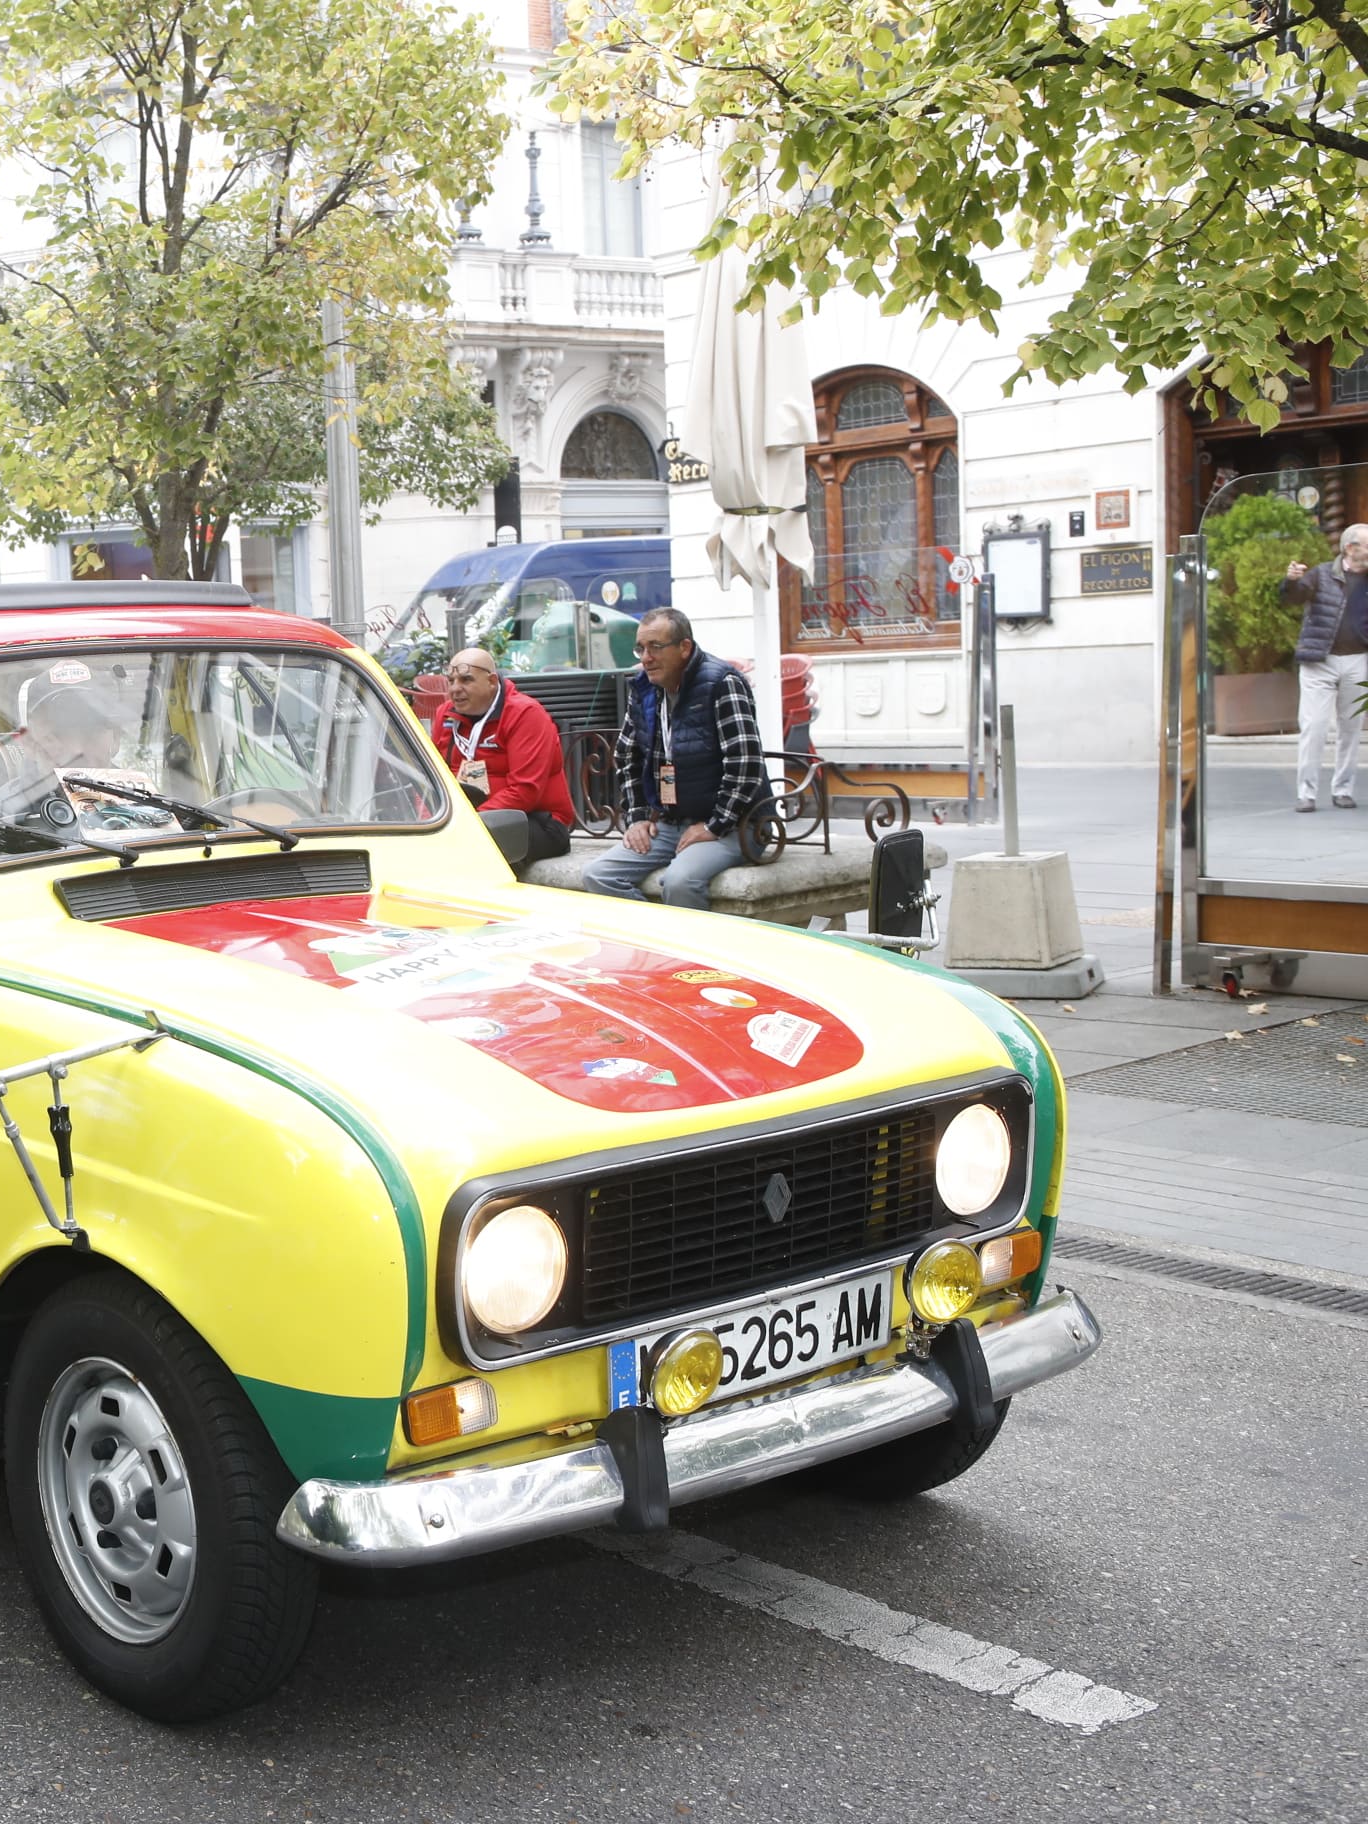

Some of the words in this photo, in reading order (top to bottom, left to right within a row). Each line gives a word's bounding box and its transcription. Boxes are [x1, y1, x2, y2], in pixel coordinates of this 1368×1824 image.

[1083, 555, 1097, 568] EL
[1101, 552, 1141, 566] FIGON
[1083, 577, 1150, 590] RECOLETOS
[364, 948, 460, 984] HAPPY
[713, 1300, 820, 1386] 5265
[832, 1283, 883, 1353] AM
[618, 1389, 630, 1408] E
